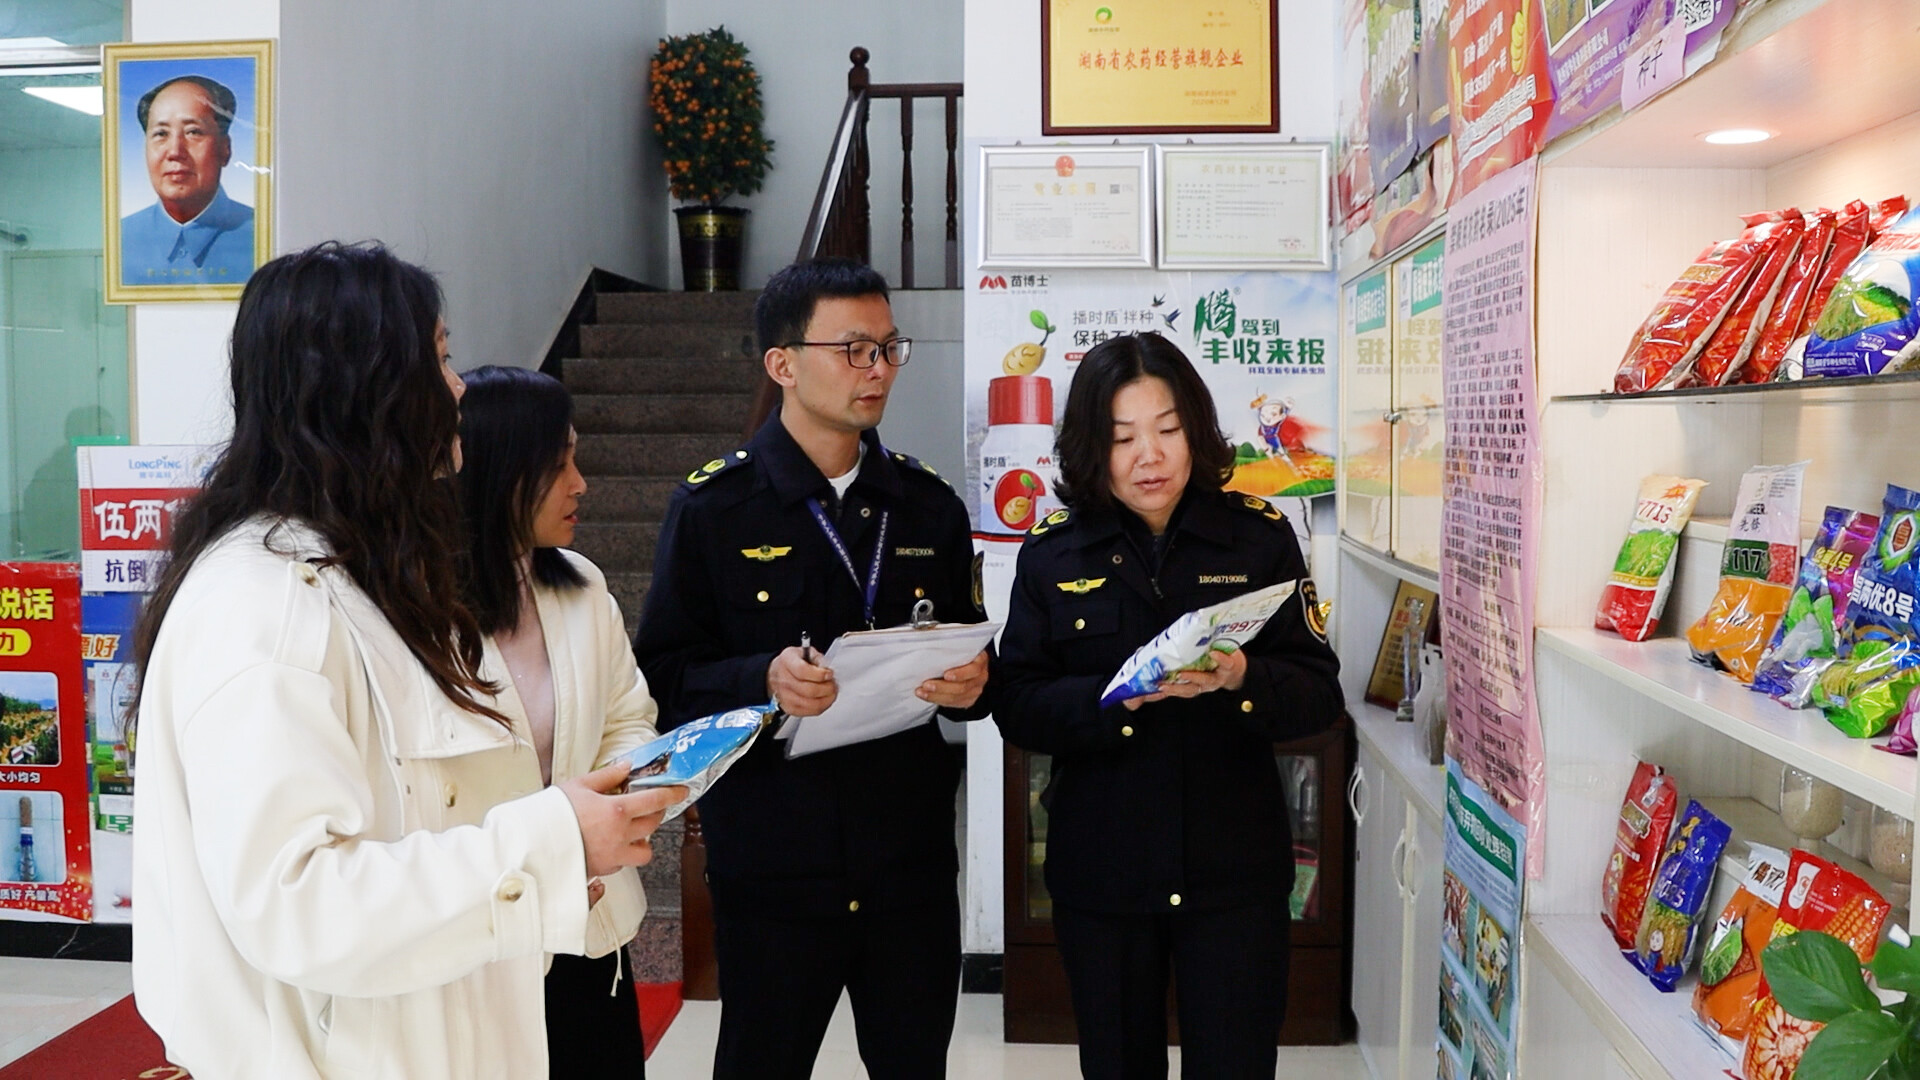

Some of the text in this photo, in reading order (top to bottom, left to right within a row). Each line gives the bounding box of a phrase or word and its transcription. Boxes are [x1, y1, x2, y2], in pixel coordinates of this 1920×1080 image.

[1079, 47, 1244, 71] 湖南省农药经营旗舰企业
[1010, 275, 1048, 288] 苗博士
[1073, 310, 1154, 325] 播时盾 拌种
[1193, 288, 1236, 347] 腾
[1241, 319, 1280, 336] 驾到
[1202, 338, 1325, 365] 丰收来报
[93, 499, 180, 541] 伍两
[0, 587, 55, 620] 说话
